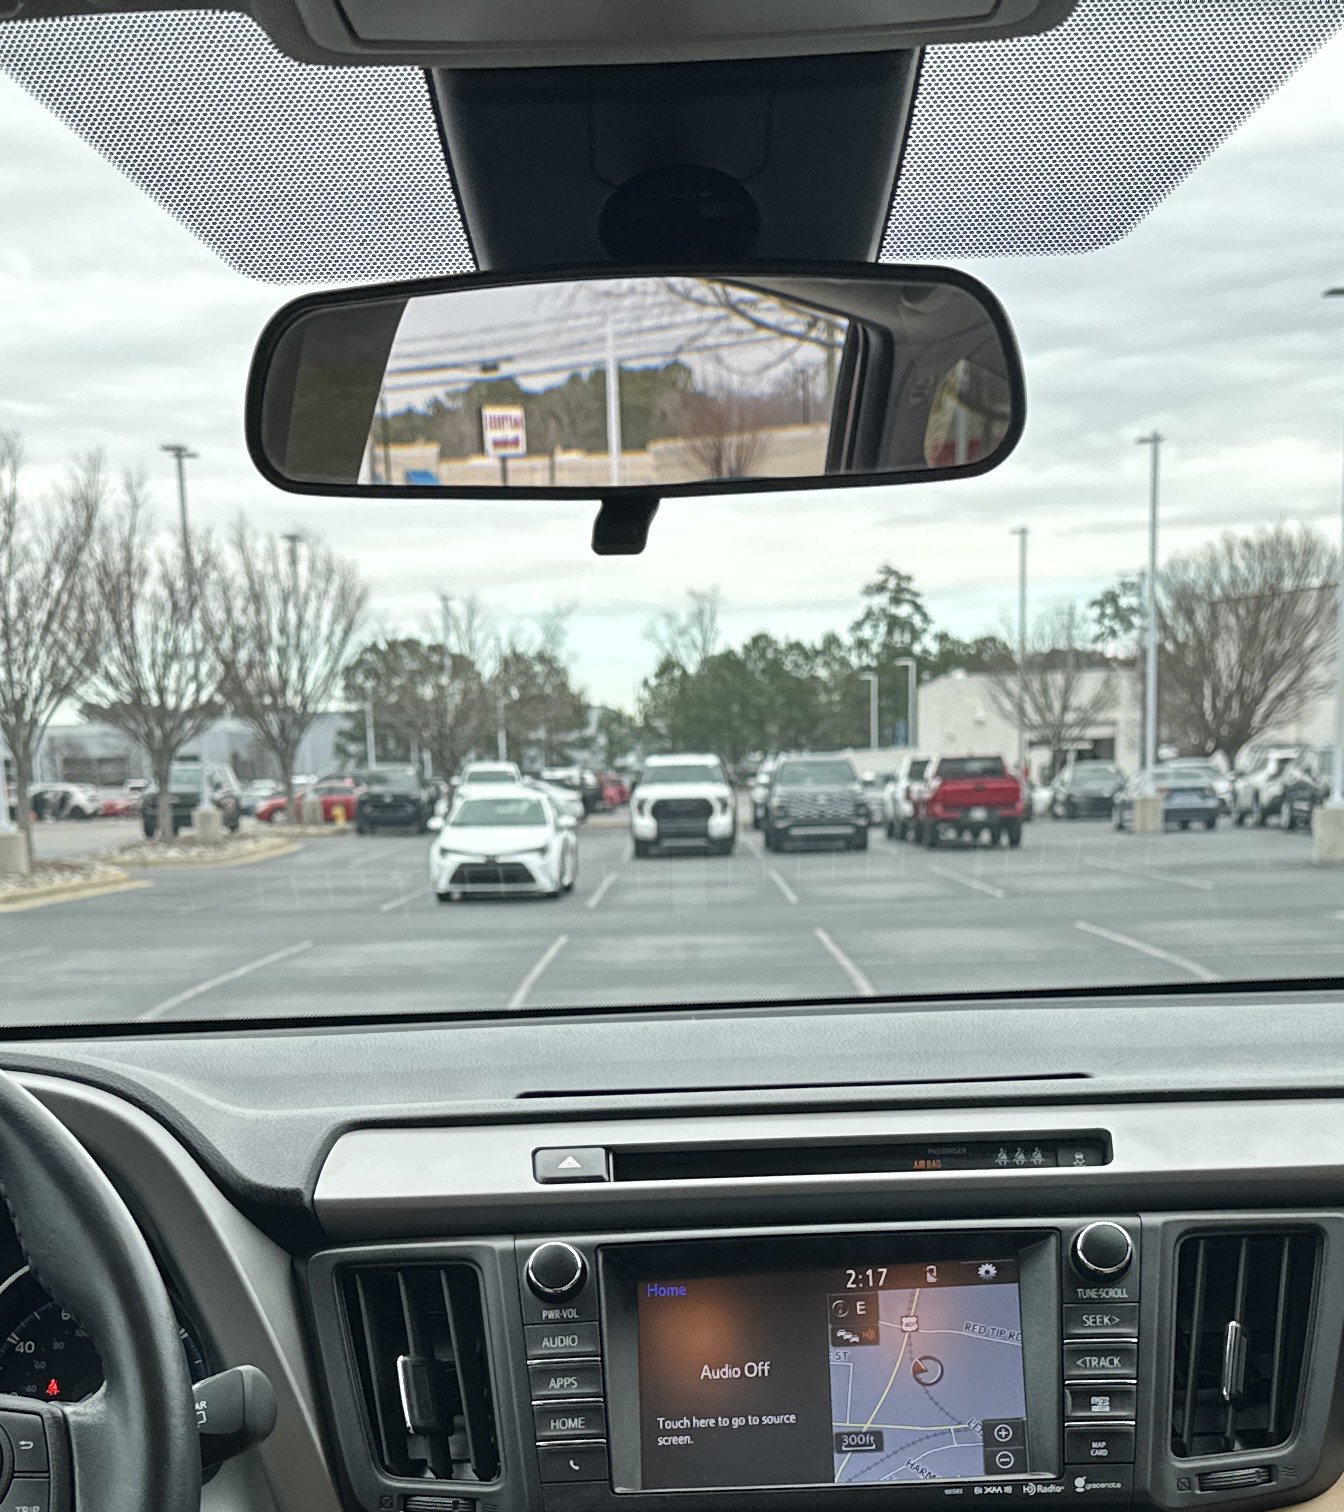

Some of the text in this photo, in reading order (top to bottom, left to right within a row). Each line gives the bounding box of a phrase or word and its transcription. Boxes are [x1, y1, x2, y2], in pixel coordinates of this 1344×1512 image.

[913, 1159, 942, 1169] AIR BAG
[845, 1267, 888, 1289] 2:17
[647, 1283, 687, 1298] Home
[855, 1302, 867, 1316] E
[964, 1322, 987, 1335] RED
[989, 1326, 1007, 1338] TIP
[15, 1340, 36, 1354] 40
[541, 1334, 579, 1348] AUDIO
[835, 1351, 849, 1362] ST
[700, 1360, 771, 1380] Audio Off
[548, 1376, 578, 1390] APPS
[550, 1417, 586, 1431] HOME
[657, 1413, 797, 1431] Touch here to go to source
[657, 1434, 694, 1446] screen.
[841, 1434, 876, 1446] 300ft
[1091, 1441, 1107, 1449] MAP
[1090, 1449, 1109, 1457] CARD
